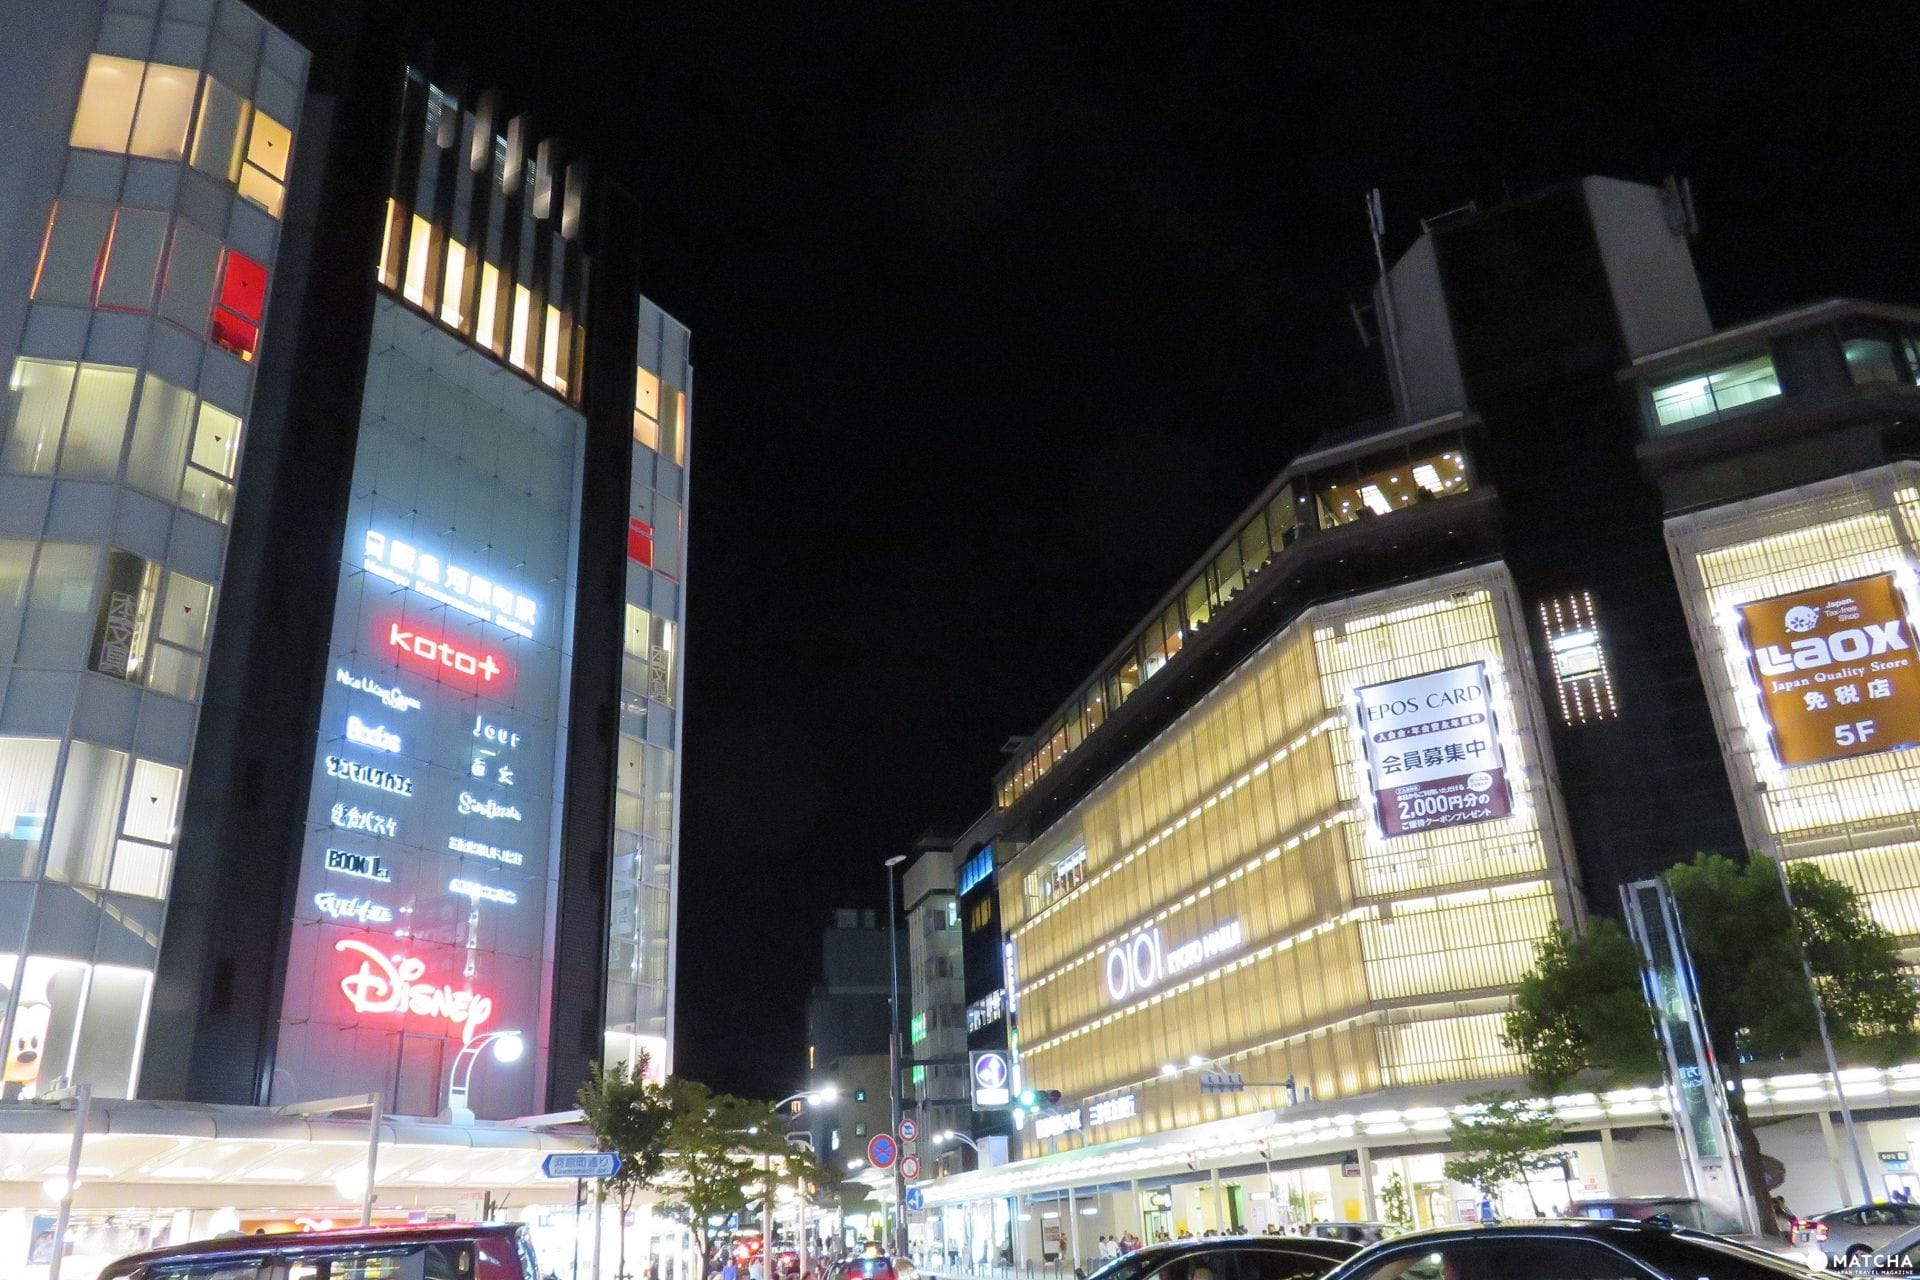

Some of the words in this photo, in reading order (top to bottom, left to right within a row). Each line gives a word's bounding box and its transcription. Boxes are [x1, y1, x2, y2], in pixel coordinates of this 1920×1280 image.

[1838, 612, 1861, 623] Shop
[1771, 676, 1810, 694] Japan
[1813, 665, 1866, 685] Quality
[1870, 657, 1910, 672] Store
[1367, 697, 1420, 722] EPOS
[1425, 685, 1483, 709] CARD
[1803, 678, 1892, 711] 免税店
[1834, 719, 1876, 746] 5F
[1381, 739, 1487, 775] 会員募集中
[1398, 793, 1491, 820] 2,000円分の
